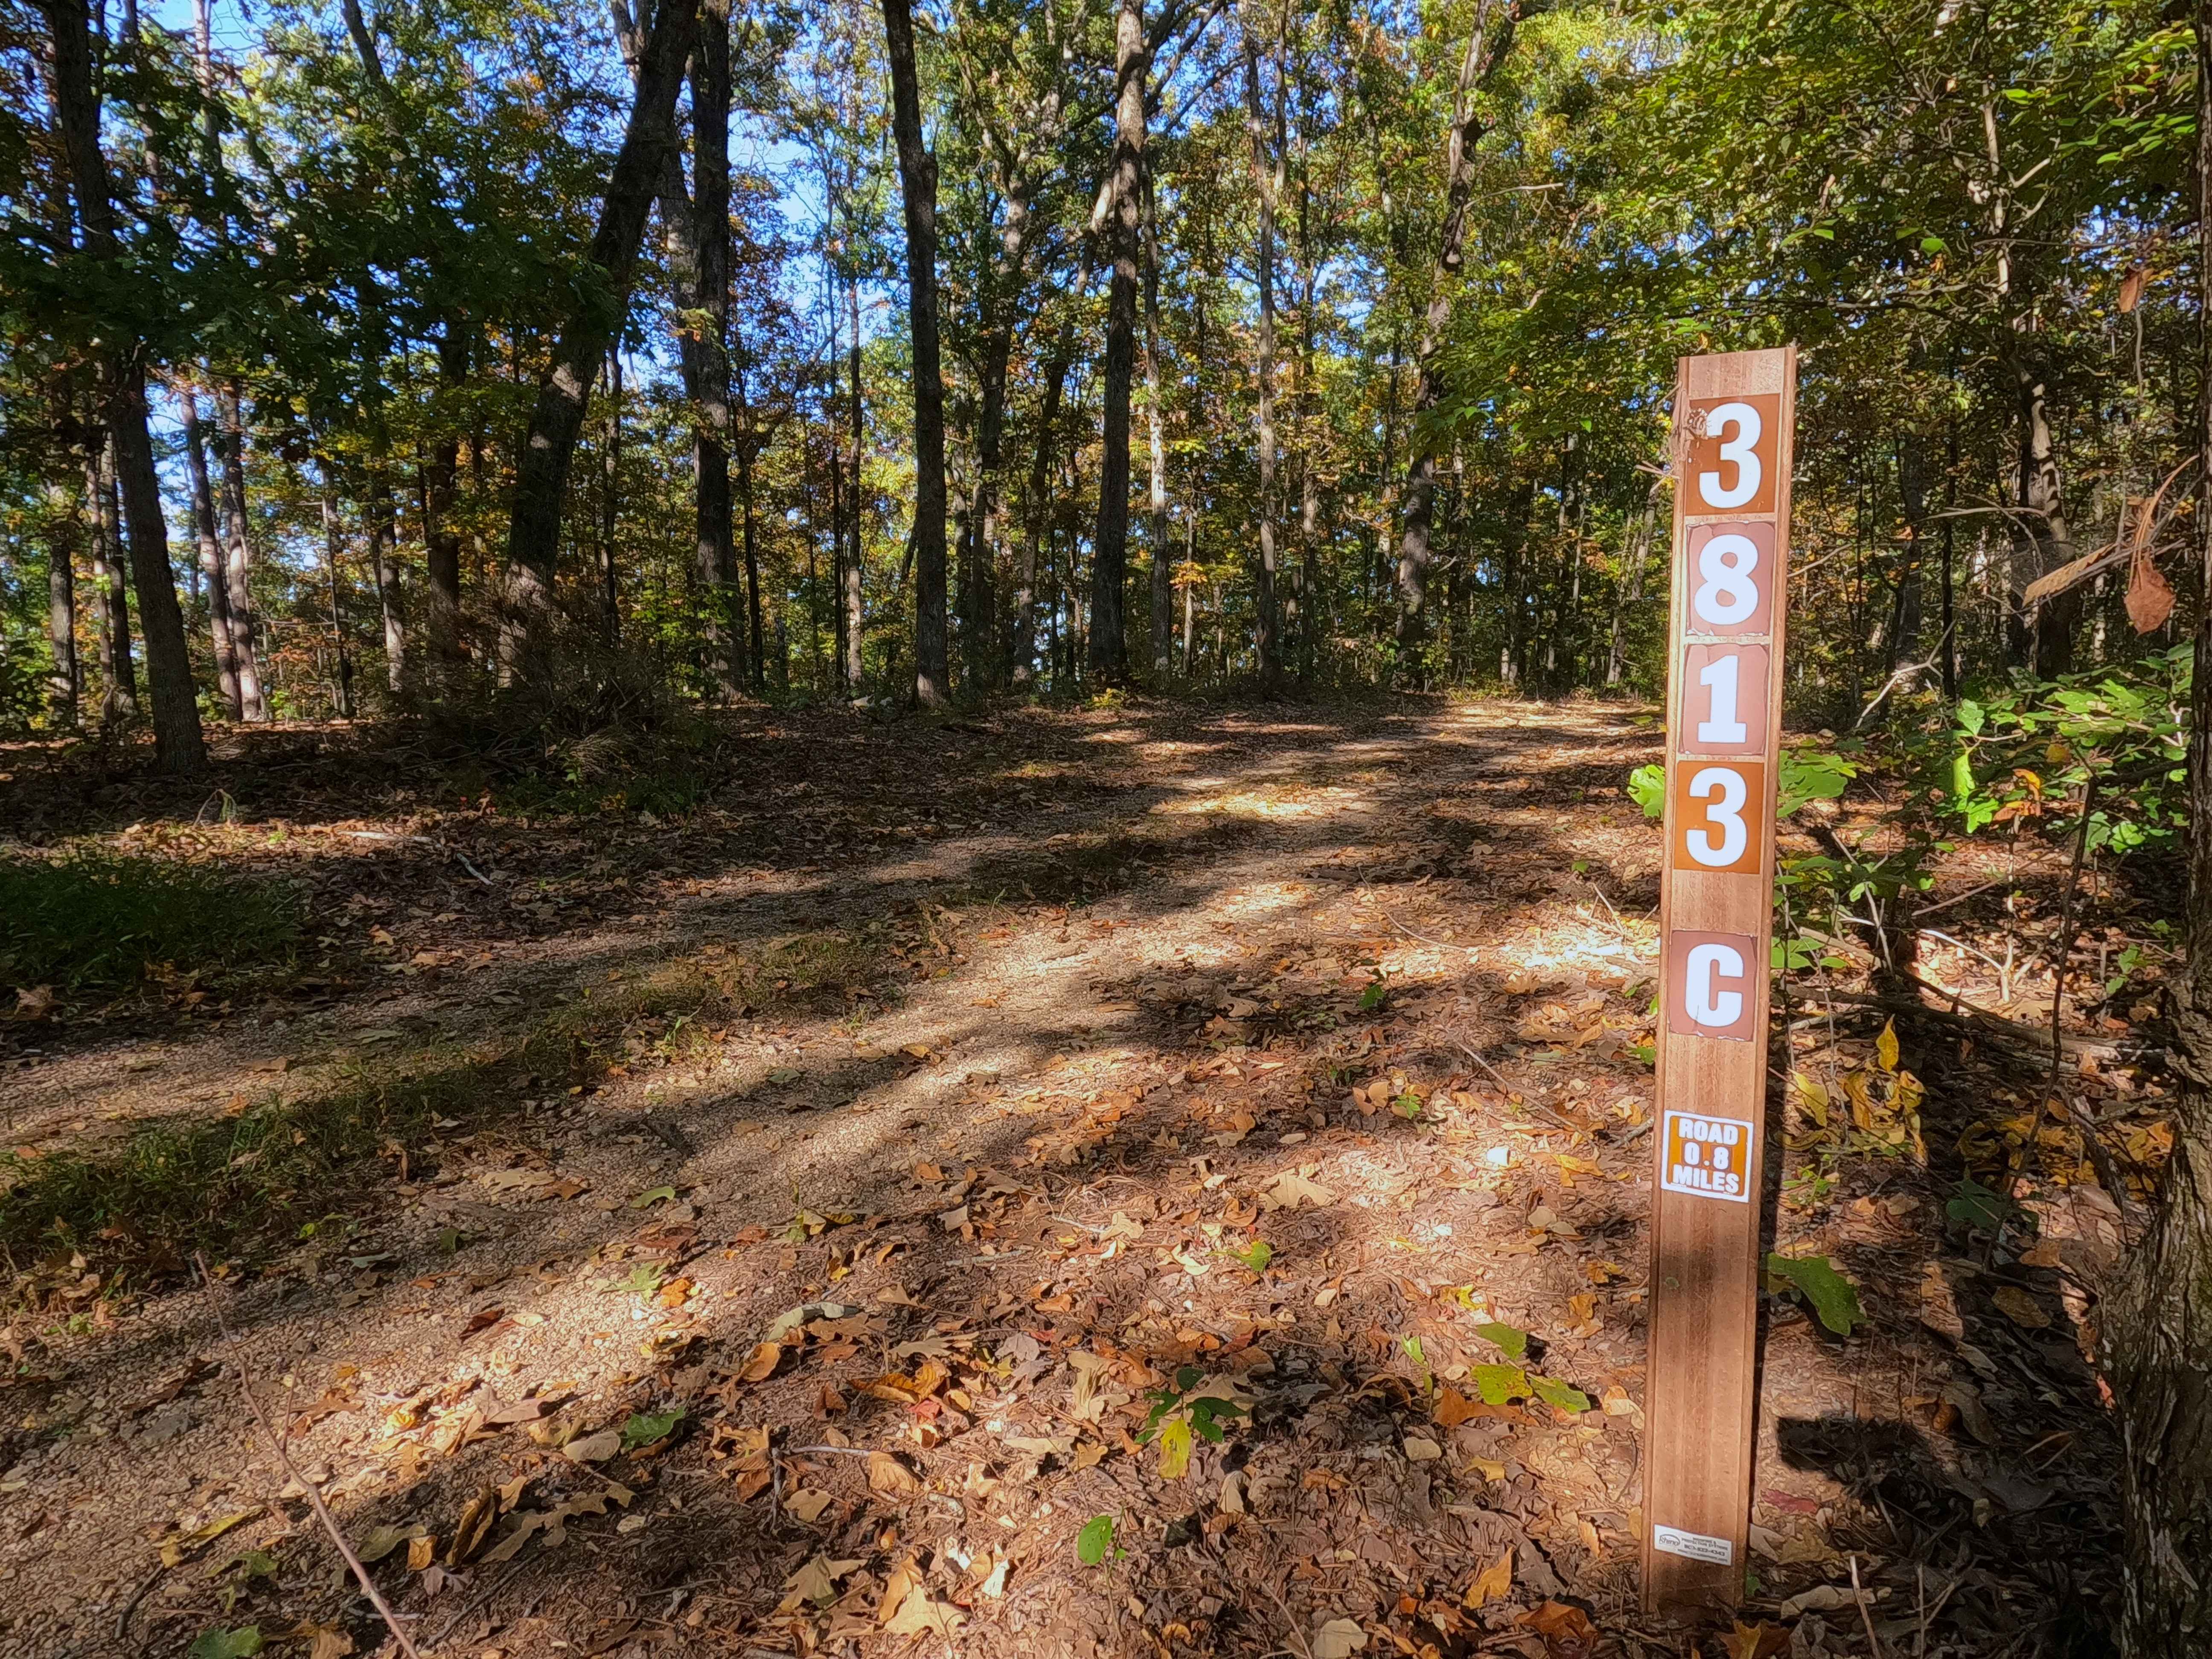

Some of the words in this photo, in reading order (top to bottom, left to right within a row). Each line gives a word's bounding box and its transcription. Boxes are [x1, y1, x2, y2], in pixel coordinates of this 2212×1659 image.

[1685, 943, 1743, 1027] C
[1679, 1118, 1738, 1145] ROAD
[1684, 1142, 1729, 1170] 0.8
[1673, 1164, 1739, 1193] MILES
